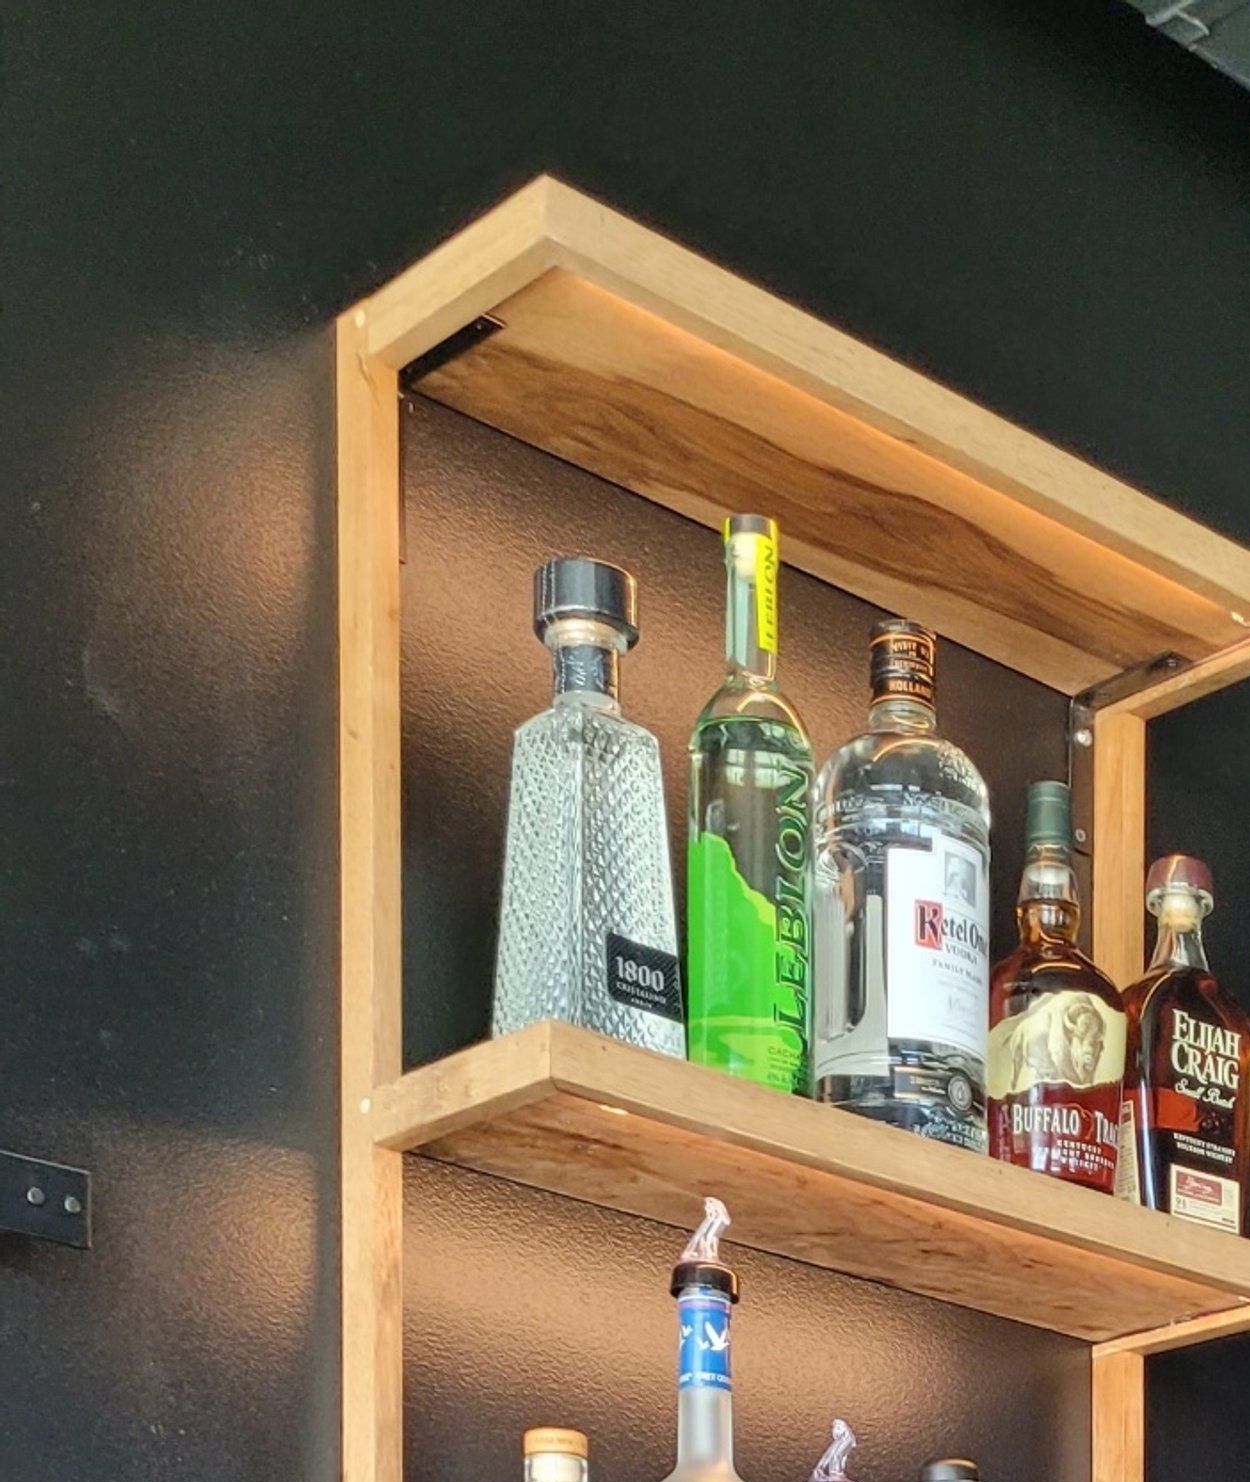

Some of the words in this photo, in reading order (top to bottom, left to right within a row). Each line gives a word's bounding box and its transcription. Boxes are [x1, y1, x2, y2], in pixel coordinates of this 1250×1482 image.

[774, 762, 809, 1045] LEBLON
[916, 904, 968, 944] Ketel
[615, 955, 665, 992] 1800
[1172, 1008, 1241, 1060] ELIJAH
[1171, 1041, 1240, 1090] CRAIG
[1012, 1103, 1080, 1136] BUFFALO
